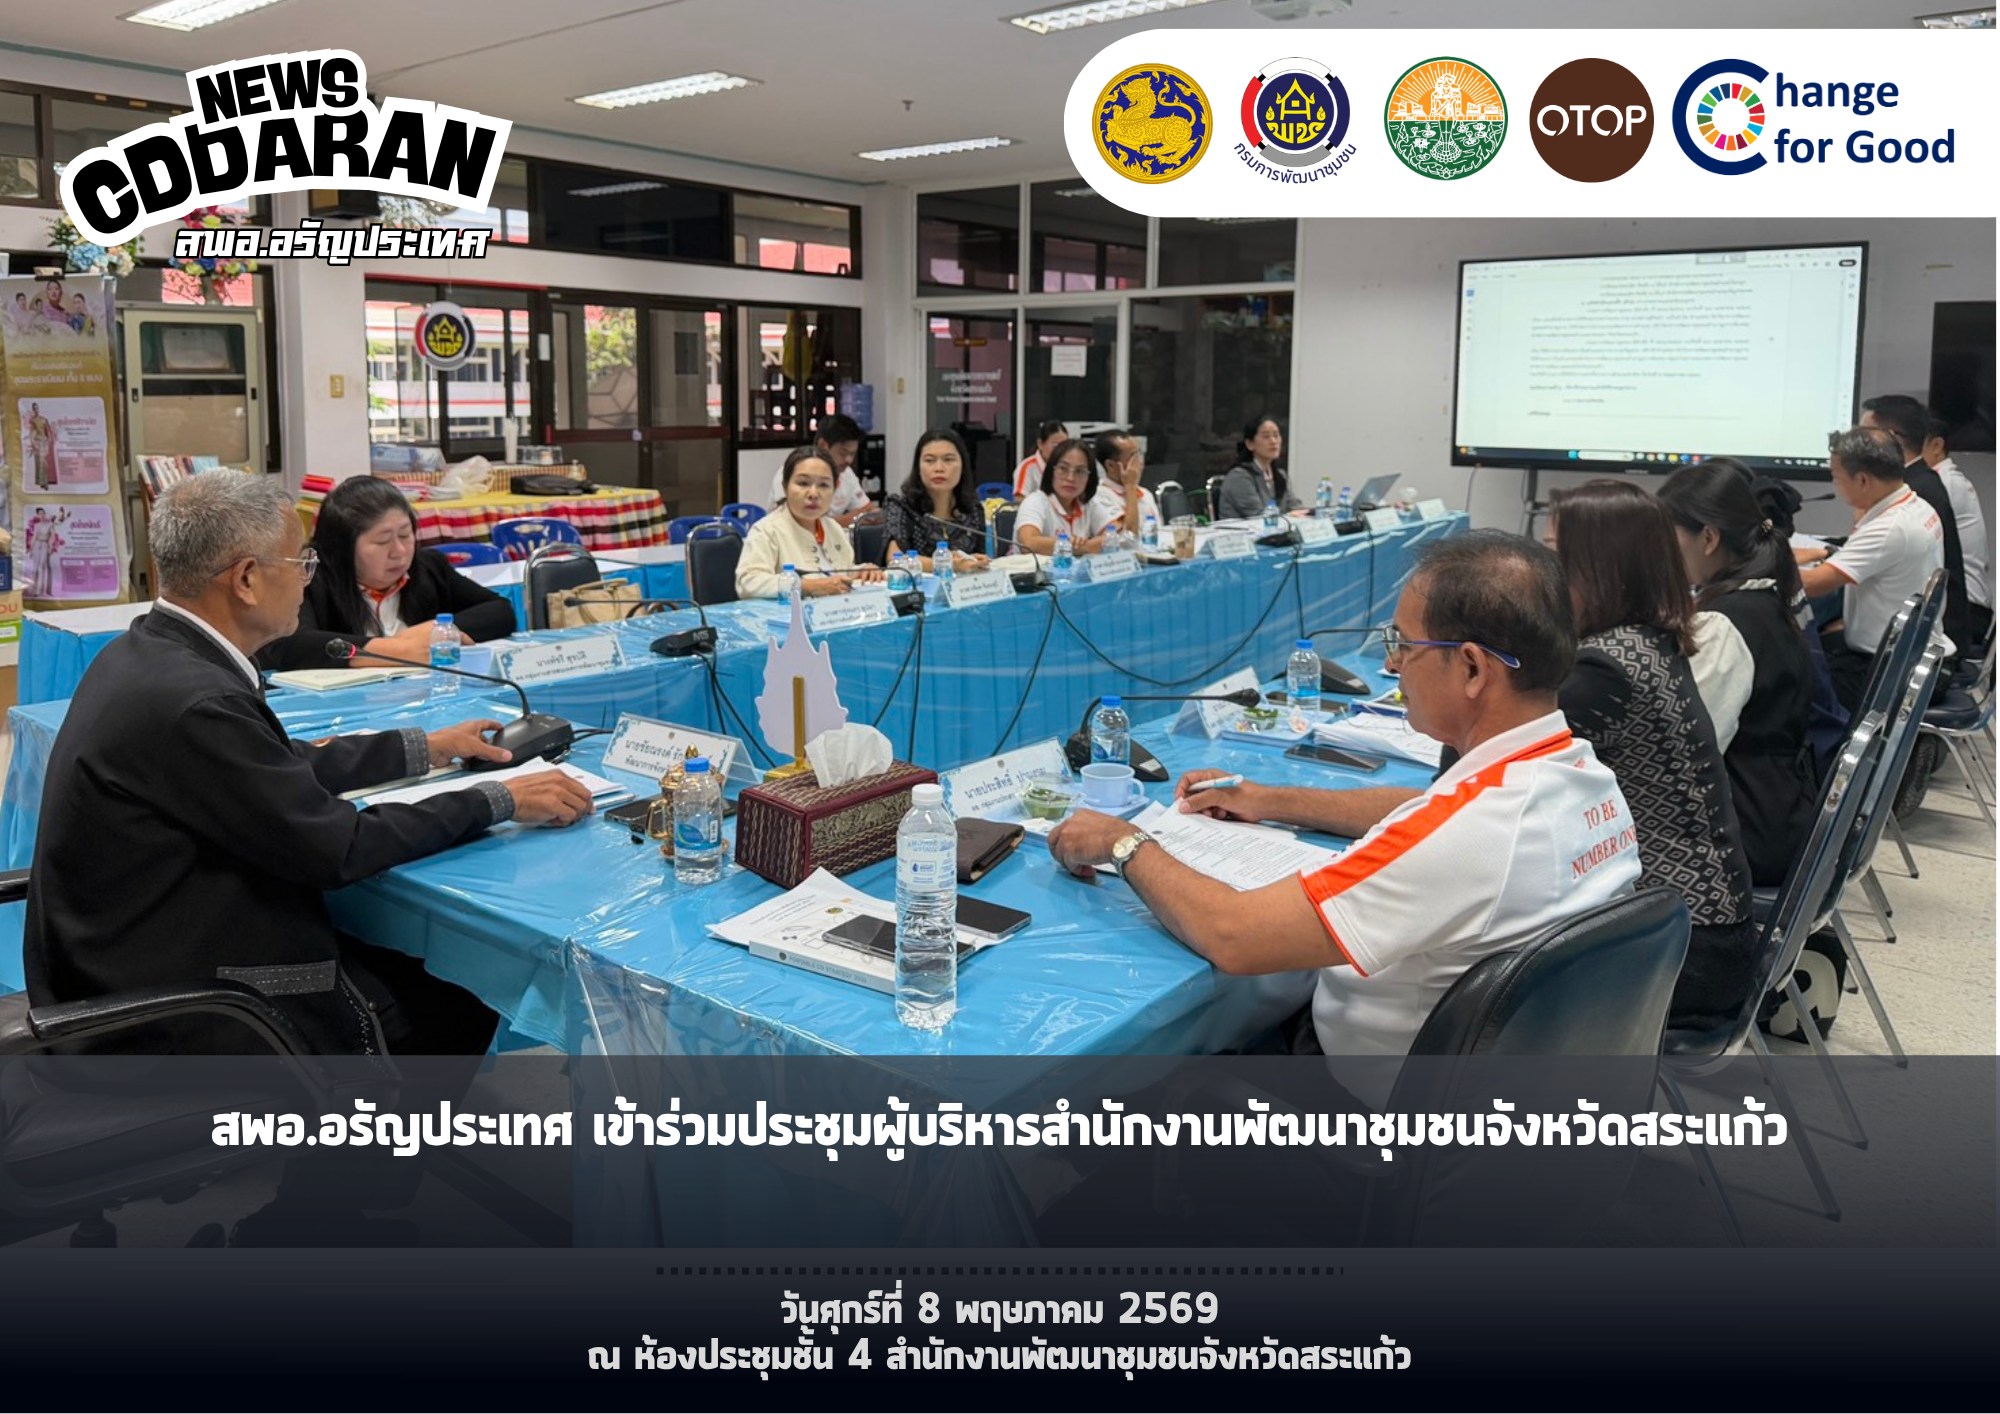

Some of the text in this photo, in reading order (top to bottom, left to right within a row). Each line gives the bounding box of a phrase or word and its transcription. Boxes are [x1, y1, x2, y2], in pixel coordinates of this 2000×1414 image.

[1583, 800, 1618, 830] TO BE
[1571, 836, 1619, 880] NUMBER
